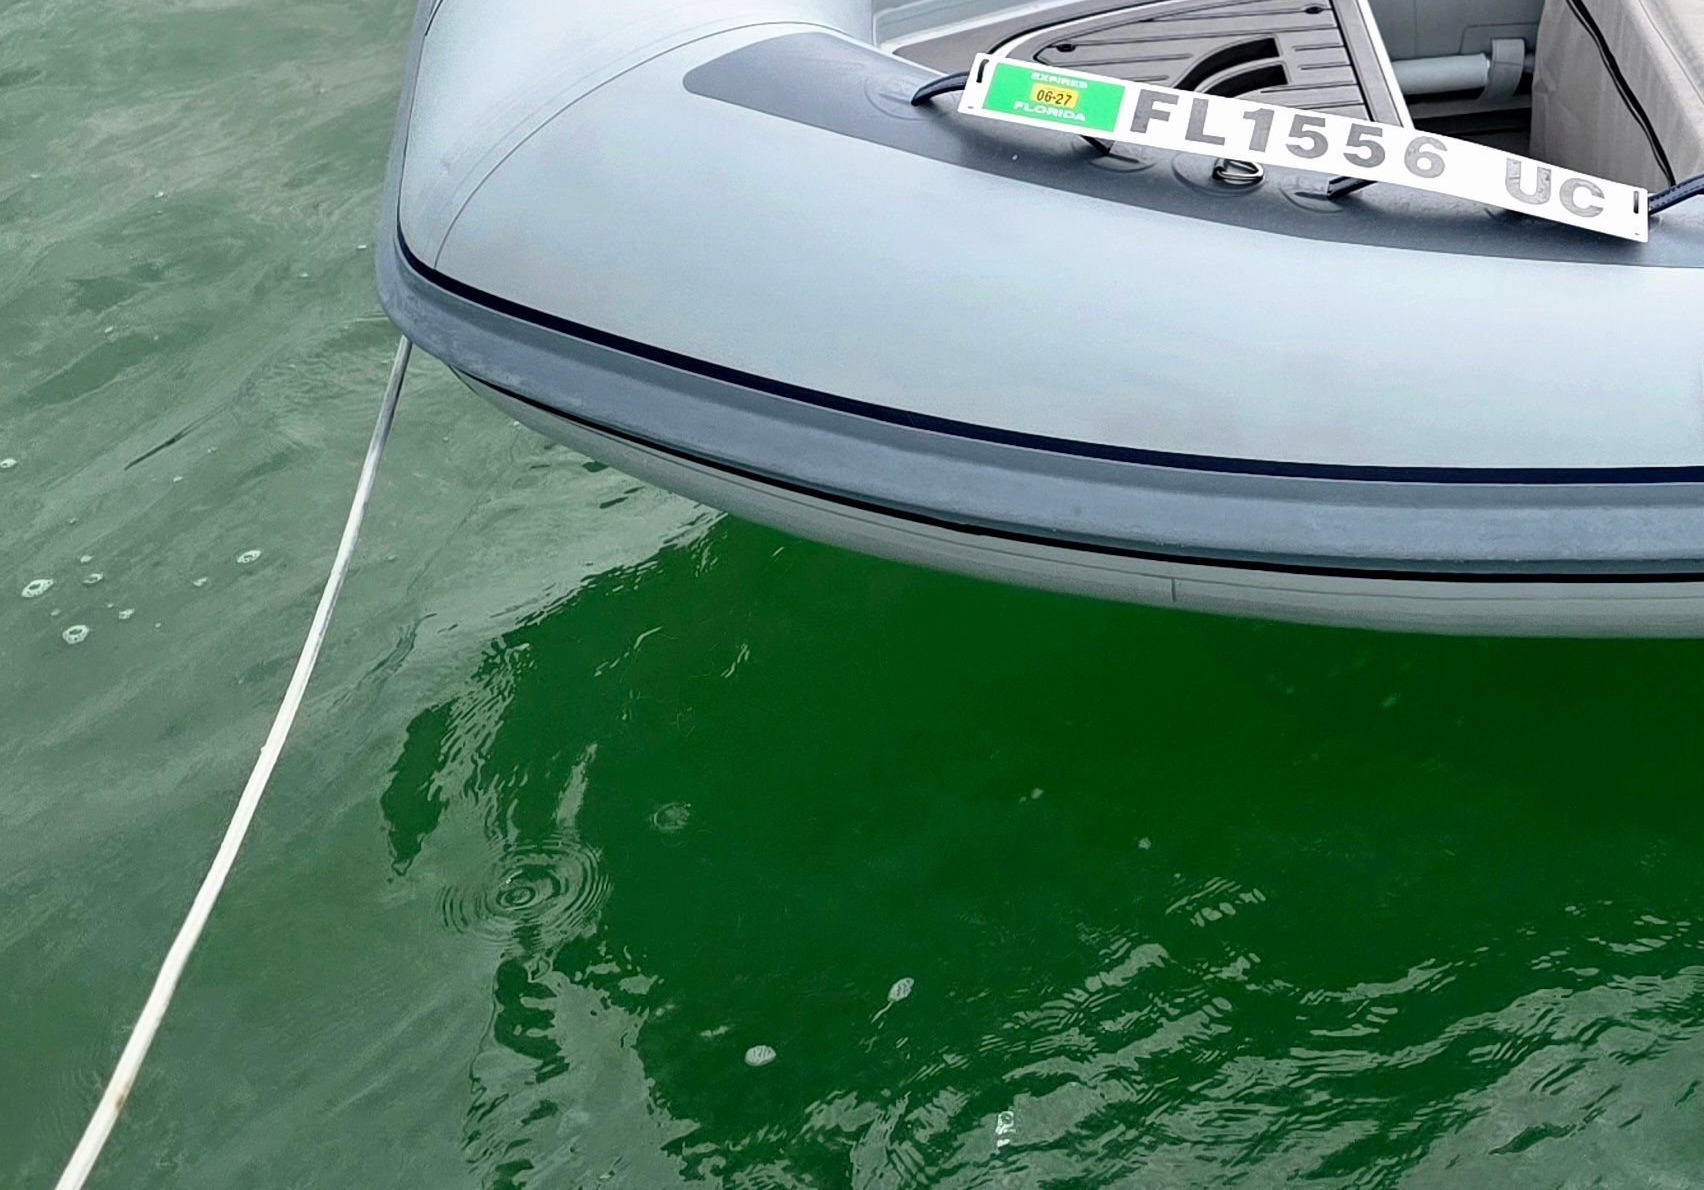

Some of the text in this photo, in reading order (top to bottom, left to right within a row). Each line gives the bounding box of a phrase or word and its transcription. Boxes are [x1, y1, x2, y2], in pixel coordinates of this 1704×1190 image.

[1031, 72, 1088, 89] EXPIRES
[1036, 89, 1073, 107] 06-27
[1013, 100, 1086, 122] FLORIDA
[1505, 159, 1606, 218] UC
